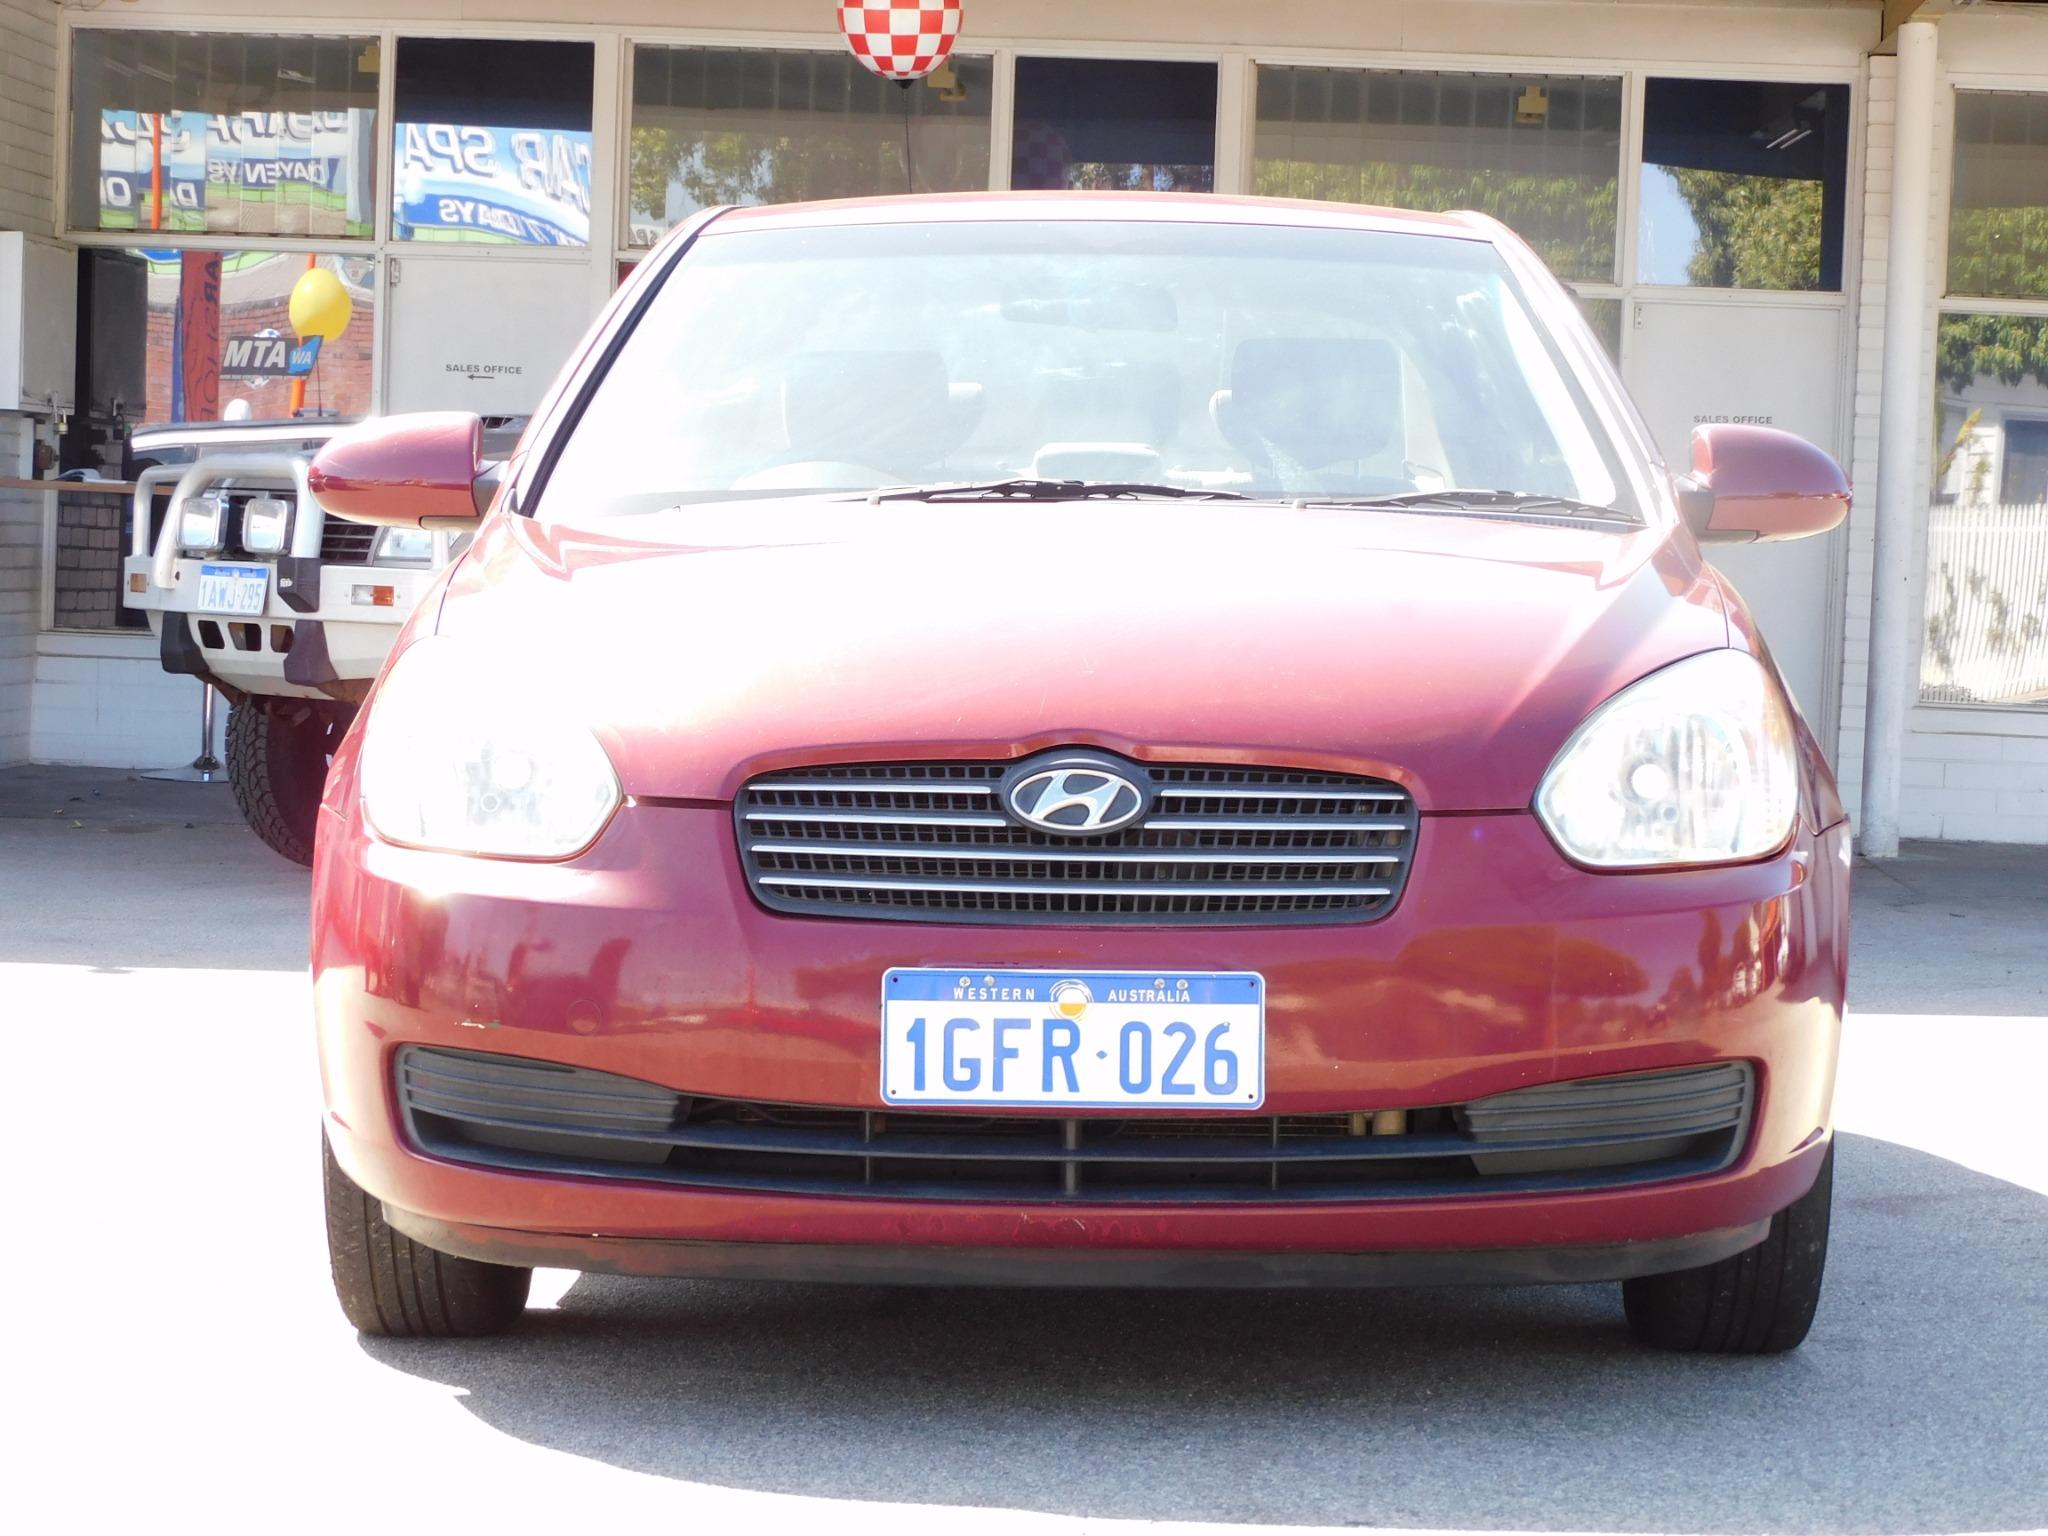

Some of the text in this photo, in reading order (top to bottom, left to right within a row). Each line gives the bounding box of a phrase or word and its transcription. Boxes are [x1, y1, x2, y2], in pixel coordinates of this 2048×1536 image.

[223, 339, 313, 368] MTA WA
[445, 363, 523, 375] SALES OFFICE
[1693, 415, 1773, 425] SALES OFFICE
[953, 987, 1191, 1003] WESTERN AUSTRALIA
